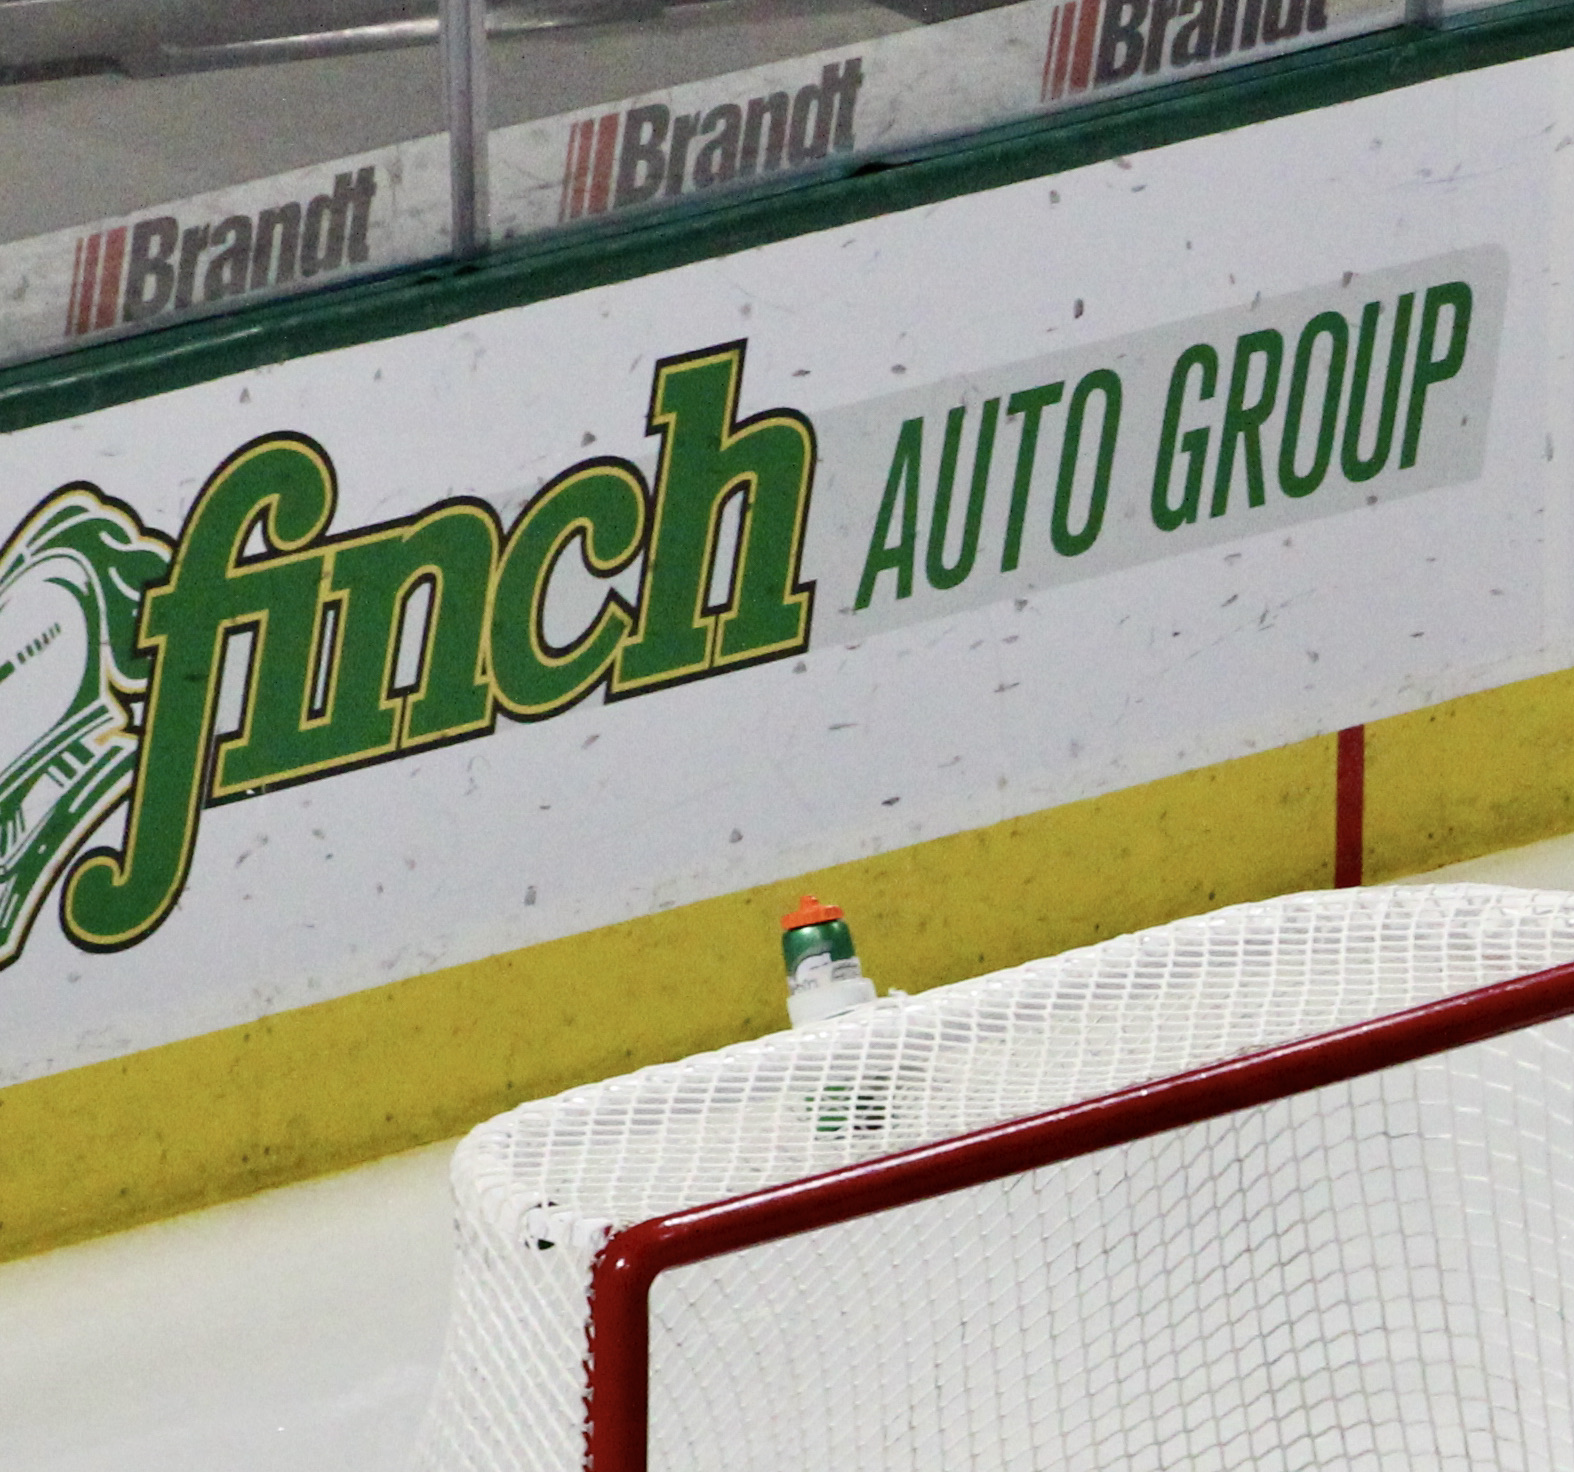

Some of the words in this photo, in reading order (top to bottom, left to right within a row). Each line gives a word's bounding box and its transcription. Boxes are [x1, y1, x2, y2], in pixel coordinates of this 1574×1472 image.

[614, 57, 864, 204] Brandt
[123, 165, 379, 322] Brandt
[60, 338, 818, 954] finch
[853, 368, 1123, 612] AUTO
[1150, 280, 1474, 532] GROUP
